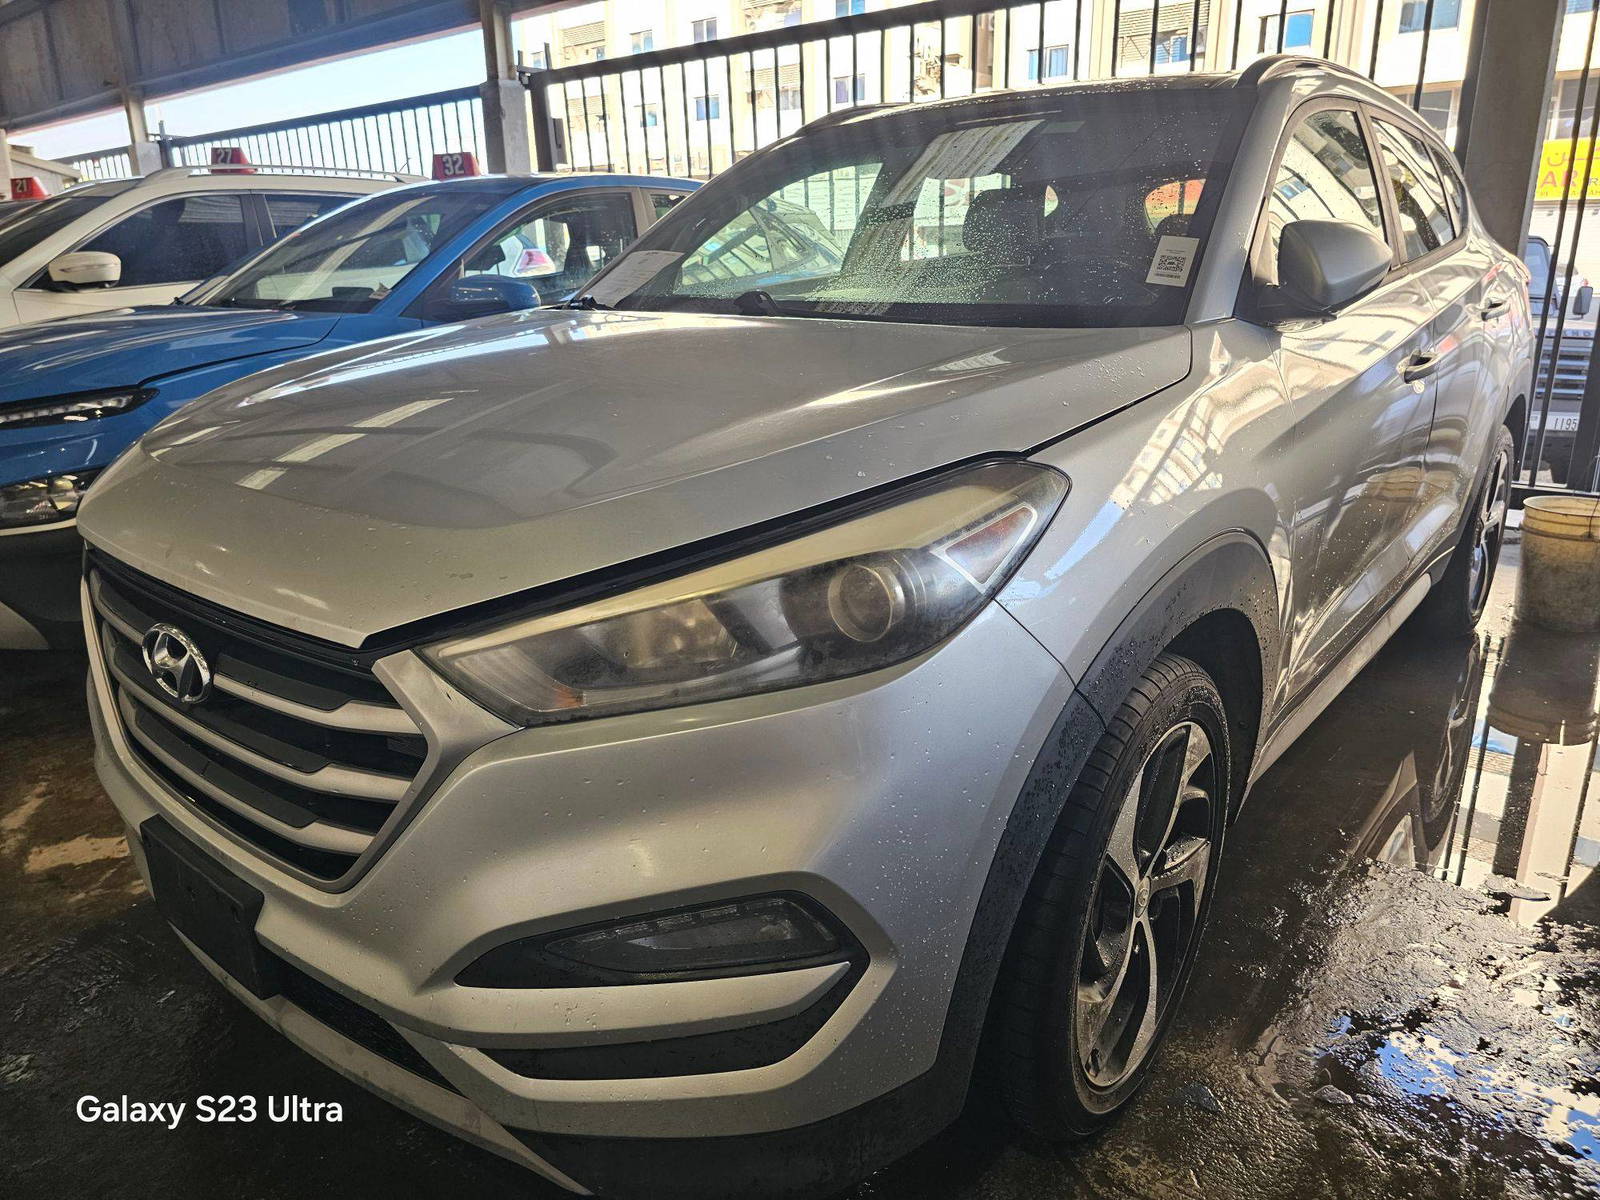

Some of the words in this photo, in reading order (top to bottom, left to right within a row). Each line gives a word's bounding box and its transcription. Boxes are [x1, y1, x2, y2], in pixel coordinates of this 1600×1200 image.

[216, 148, 232, 164] 27
[442, 154, 465, 176] 32
[15, 179, 27, 193] 21
